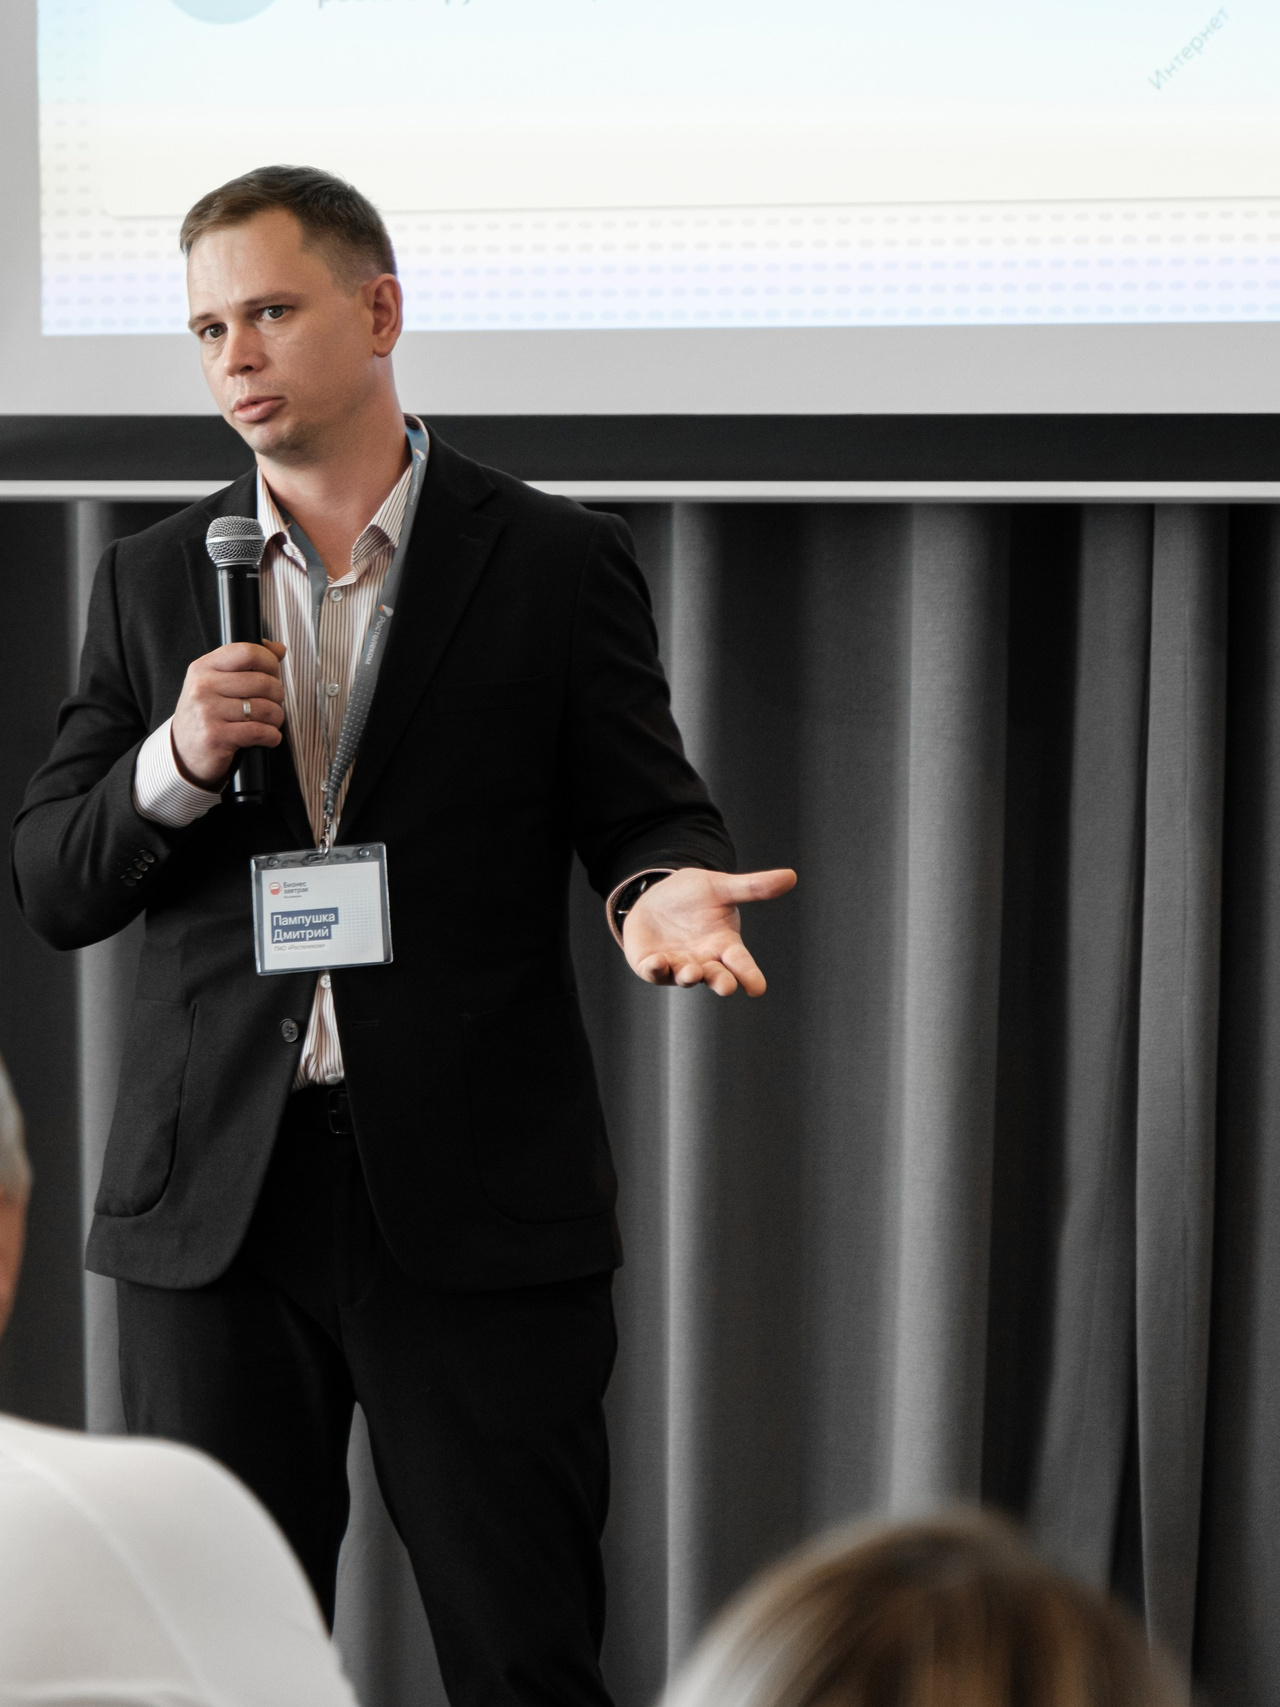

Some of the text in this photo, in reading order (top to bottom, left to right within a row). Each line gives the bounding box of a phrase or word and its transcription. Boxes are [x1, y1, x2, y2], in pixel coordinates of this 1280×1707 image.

[1147, 5, 1229, 91] Интернет
[273, 912, 336, 927] Пампушка
[273, 926, 330, 942] Дмитрий
